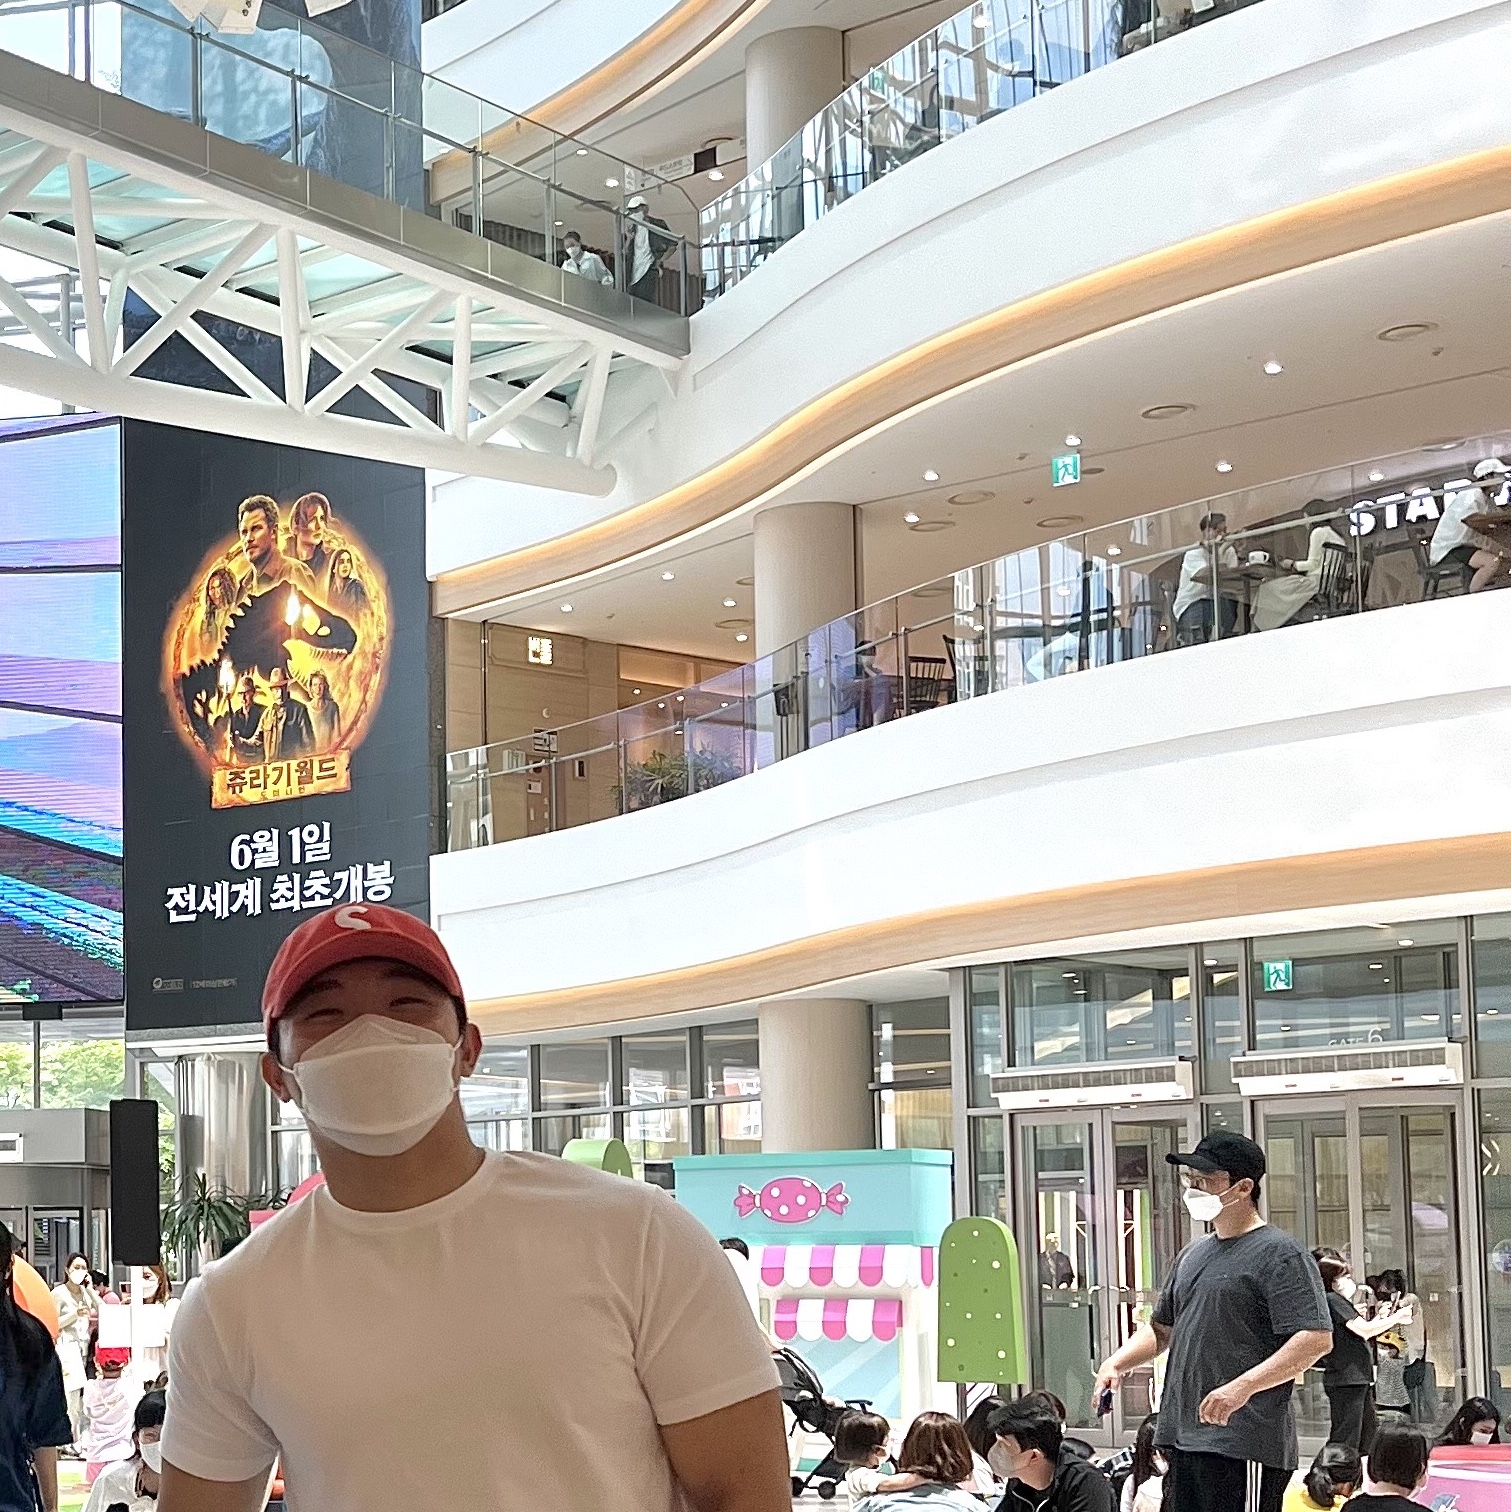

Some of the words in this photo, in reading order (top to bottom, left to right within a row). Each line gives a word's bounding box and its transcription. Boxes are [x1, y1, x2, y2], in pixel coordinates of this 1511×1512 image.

[227, 757, 338, 795] 쥬라기월드
[230, 827, 280, 871] 6월
[288, 821, 331, 865] 1일
[164, 877, 263, 924] 전세계
[270, 861, 395, 913] 최초개봉
[1368, 1027, 1383, 1044] 6
